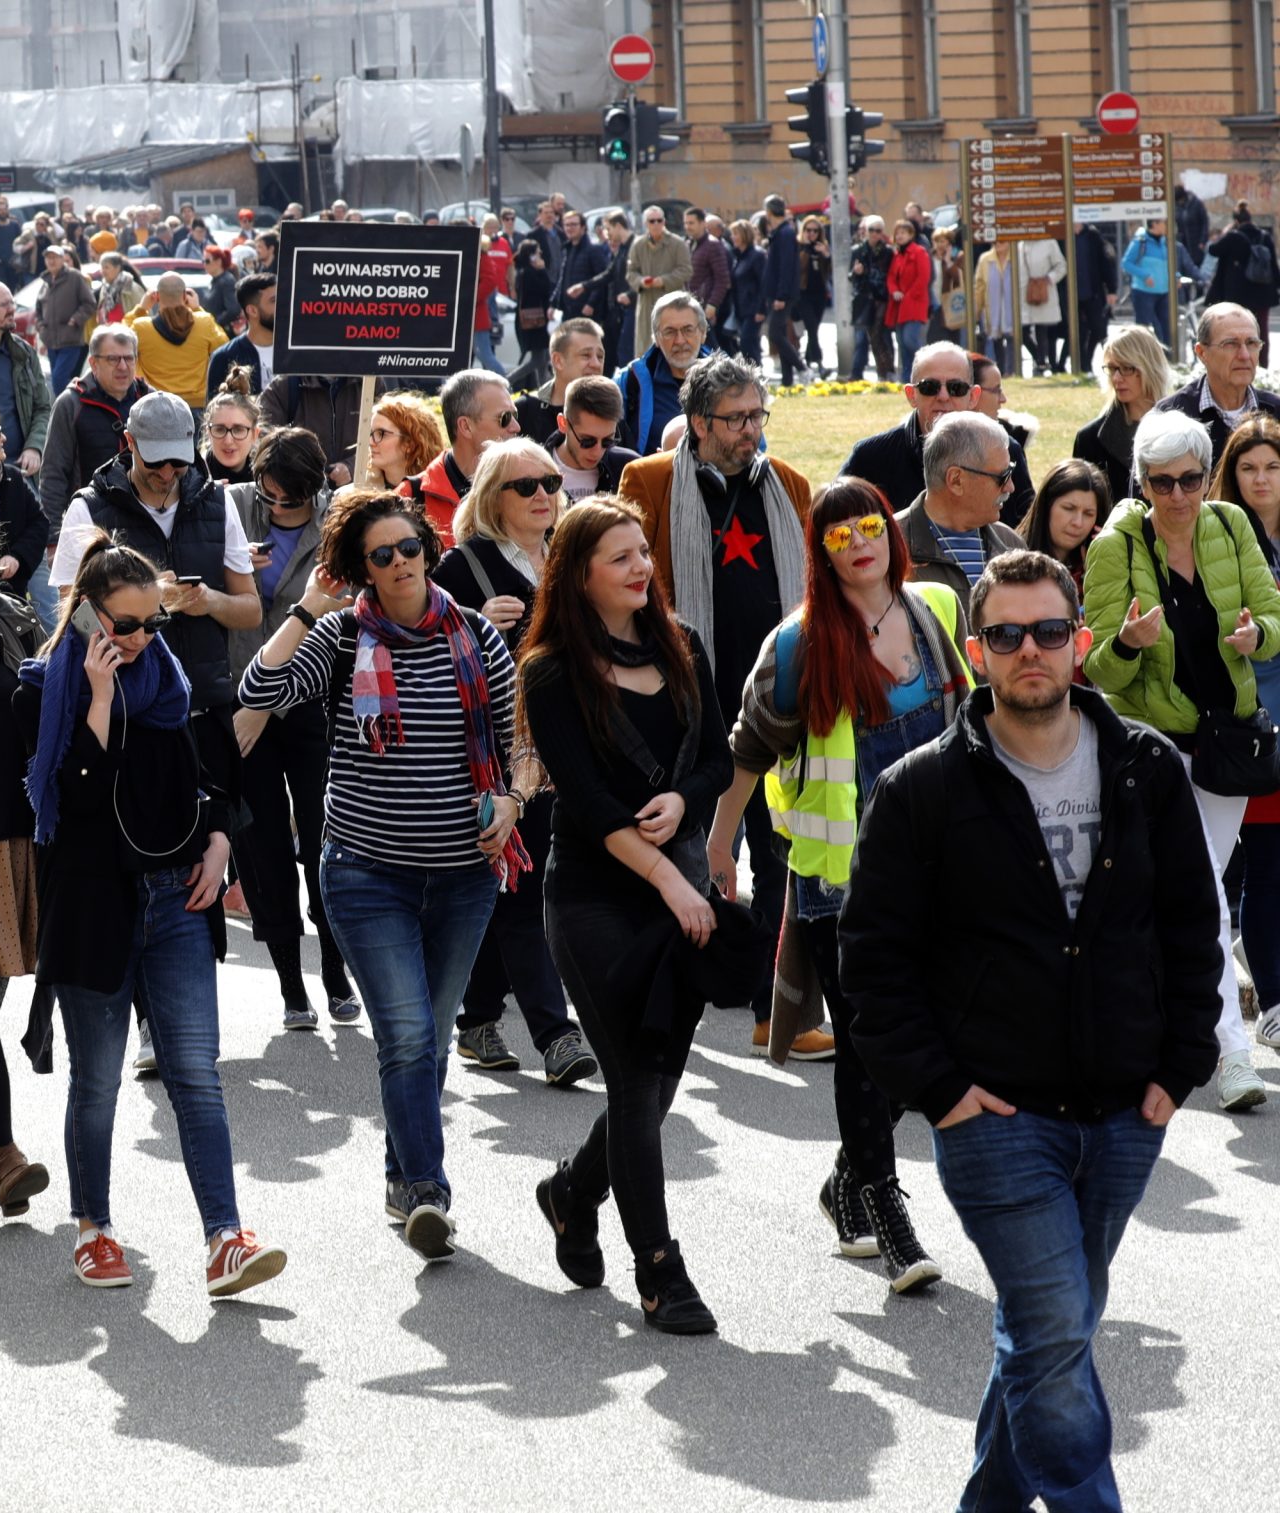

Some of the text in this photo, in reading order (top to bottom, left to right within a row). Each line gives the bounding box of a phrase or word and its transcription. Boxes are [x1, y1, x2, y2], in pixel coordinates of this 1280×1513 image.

[312, 262, 441, 278] NOVINARSTVO JE
[320, 283, 429, 299] JAVNO DOBRO
[301, 301, 447, 317] NOVINARSTVO NE
[346, 325, 400, 340] DAMO!
[377, 354, 449, 368] #Ninanana
